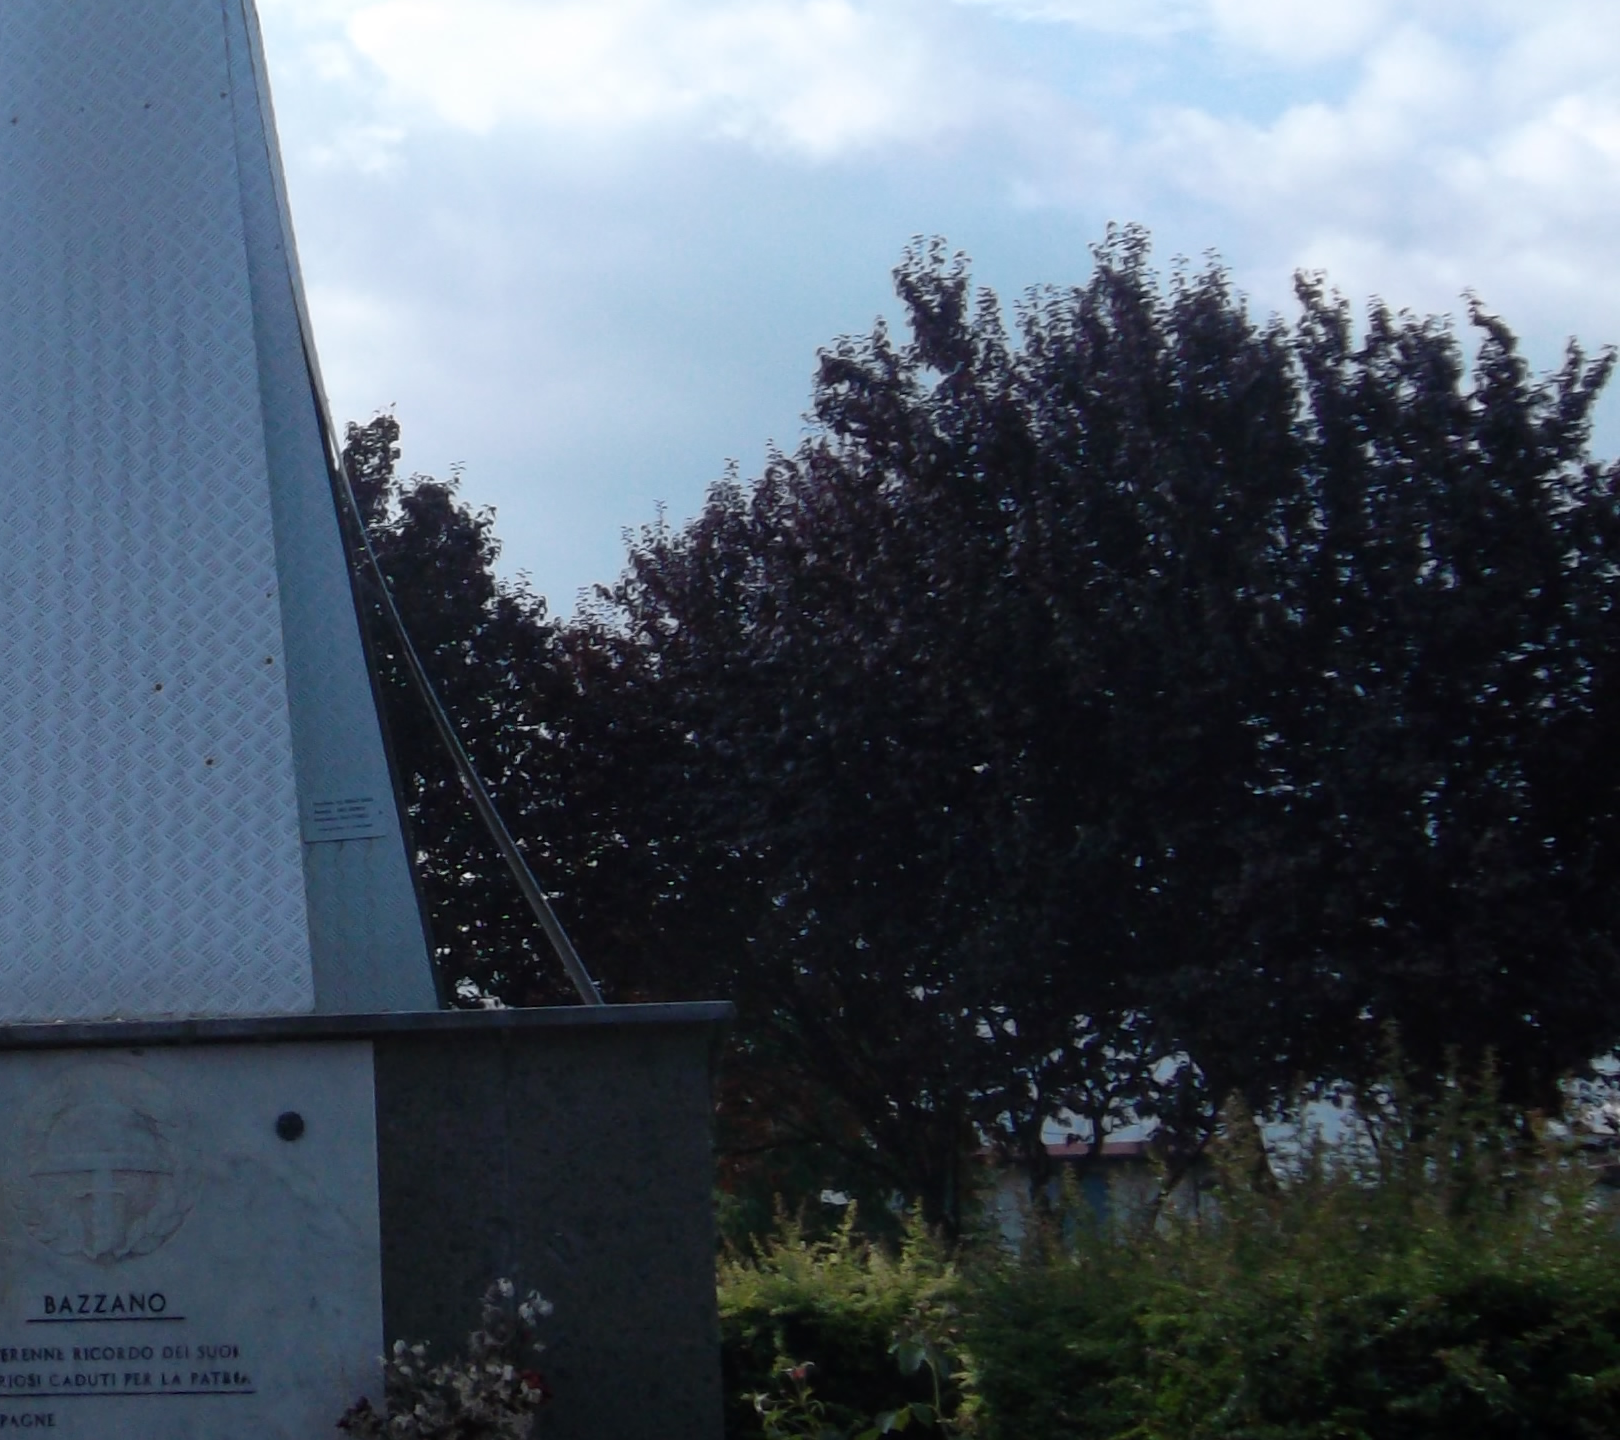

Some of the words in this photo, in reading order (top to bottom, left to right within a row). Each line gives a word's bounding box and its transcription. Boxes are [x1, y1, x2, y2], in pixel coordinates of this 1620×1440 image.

[43, 1293, 167, 1314] BAZZANO
[72, 1345, 154, 1361] RICORDO
[162, 1345, 189, 1360] DEI
[196, 1343, 240, 1359] SUOI
[48, 1373, 116, 1388] CADUTI
[123, 1372, 152, 1387] PER
[160, 1371, 182, 1386] LA
